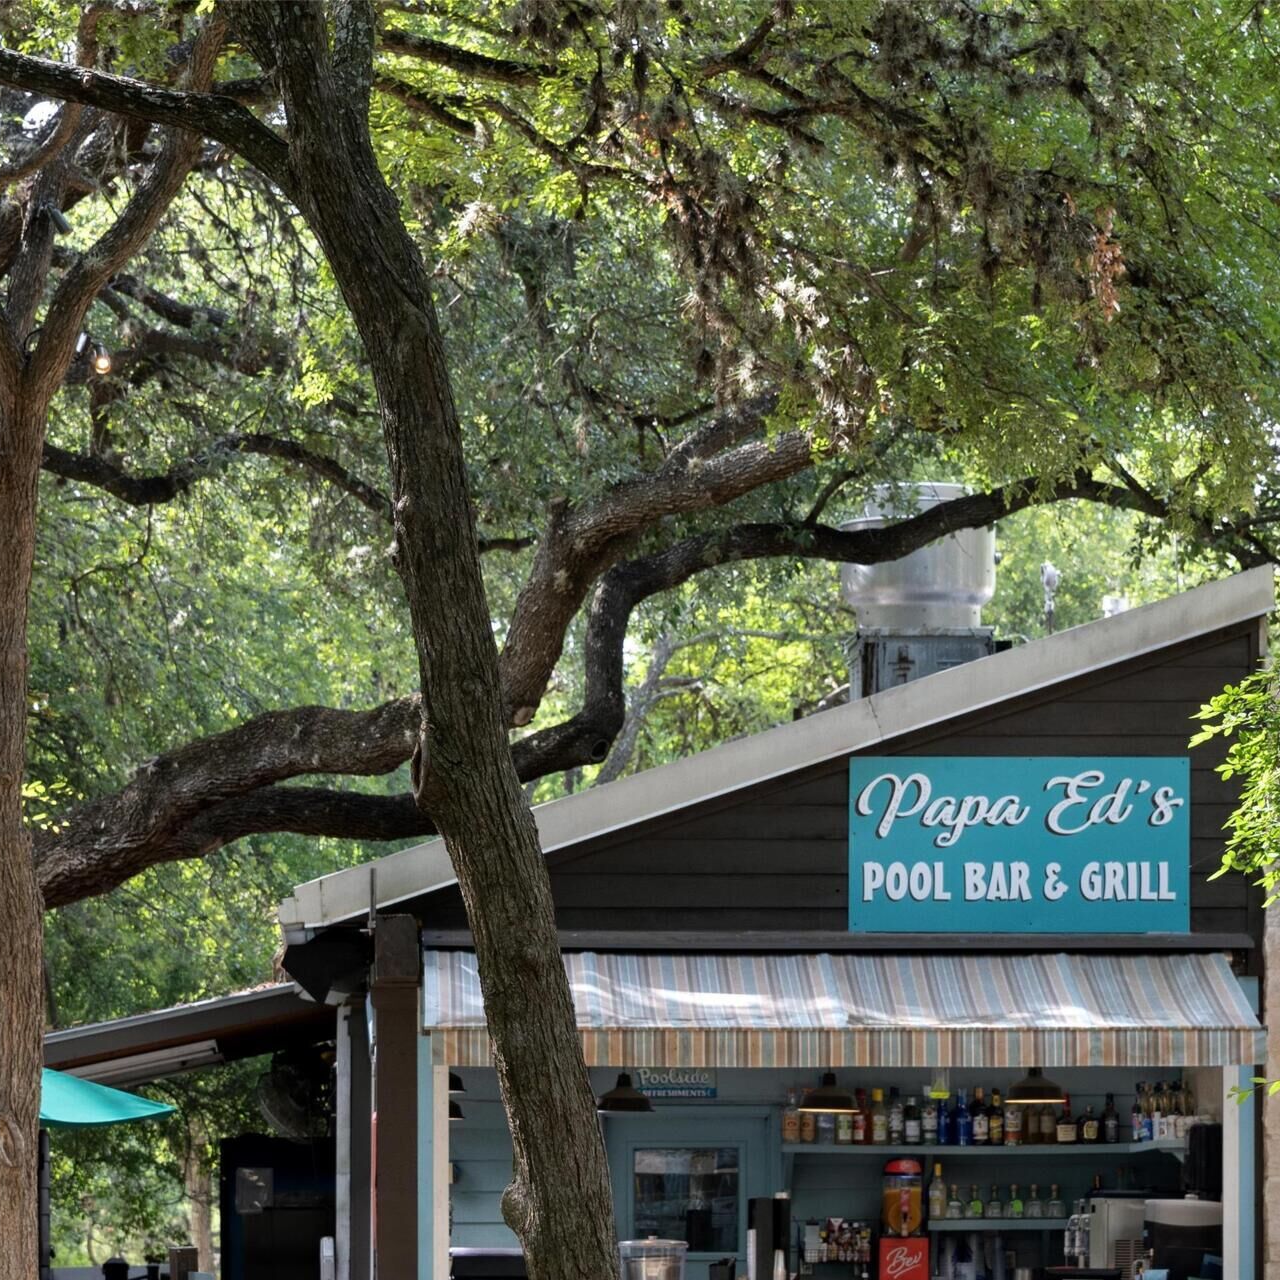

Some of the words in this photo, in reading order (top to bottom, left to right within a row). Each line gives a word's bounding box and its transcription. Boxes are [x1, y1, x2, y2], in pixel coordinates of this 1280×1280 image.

[856, 772, 1030, 848] Papa
[1044, 770, 1184, 836] Ed's
[862, 861, 951, 902] POOL
[964, 861, 1032, 902] BAR
[1044, 861, 1069, 902] &
[1080, 861, 1177, 902] GRILL
[637, 1067, 709, 1085] Poolside
